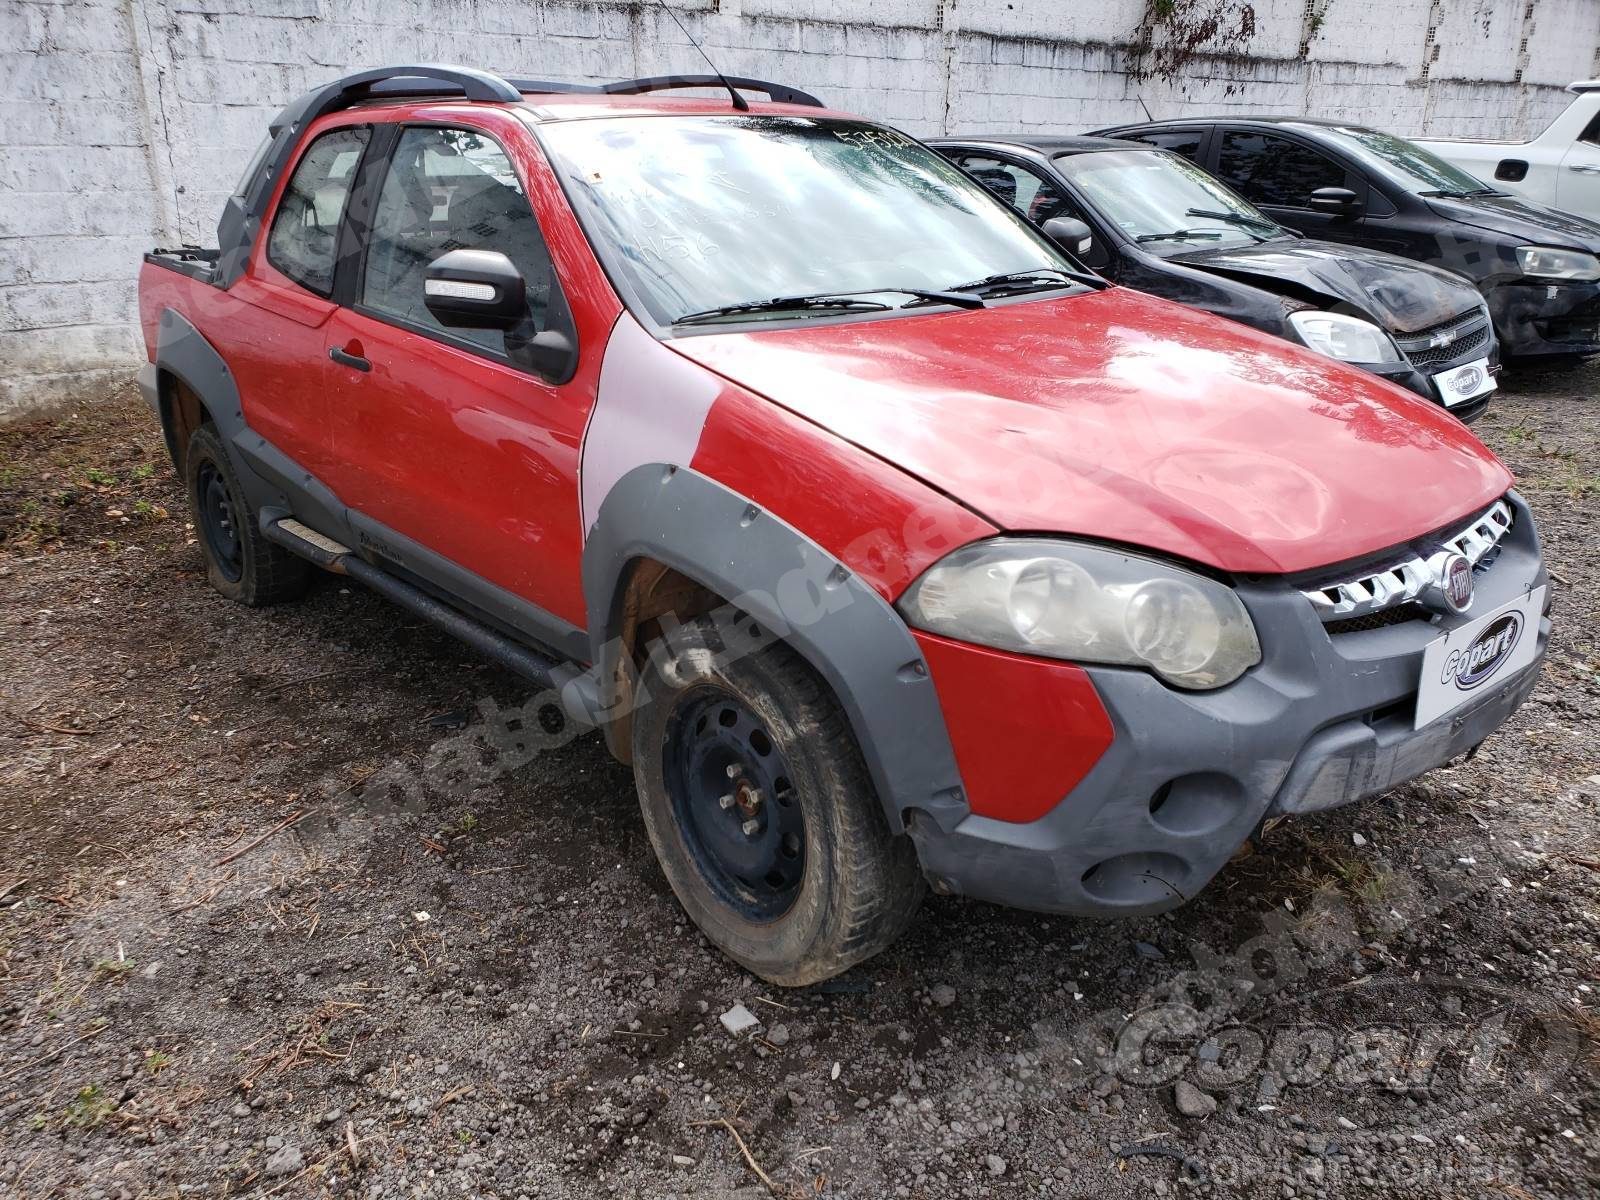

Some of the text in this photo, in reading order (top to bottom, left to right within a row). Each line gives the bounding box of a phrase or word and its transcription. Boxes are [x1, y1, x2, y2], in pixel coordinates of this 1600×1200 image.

[1447, 371, 1479, 392] Copart
[1451, 569, 1471, 601] FIAT
[1440, 617, 1517, 685] Copart
